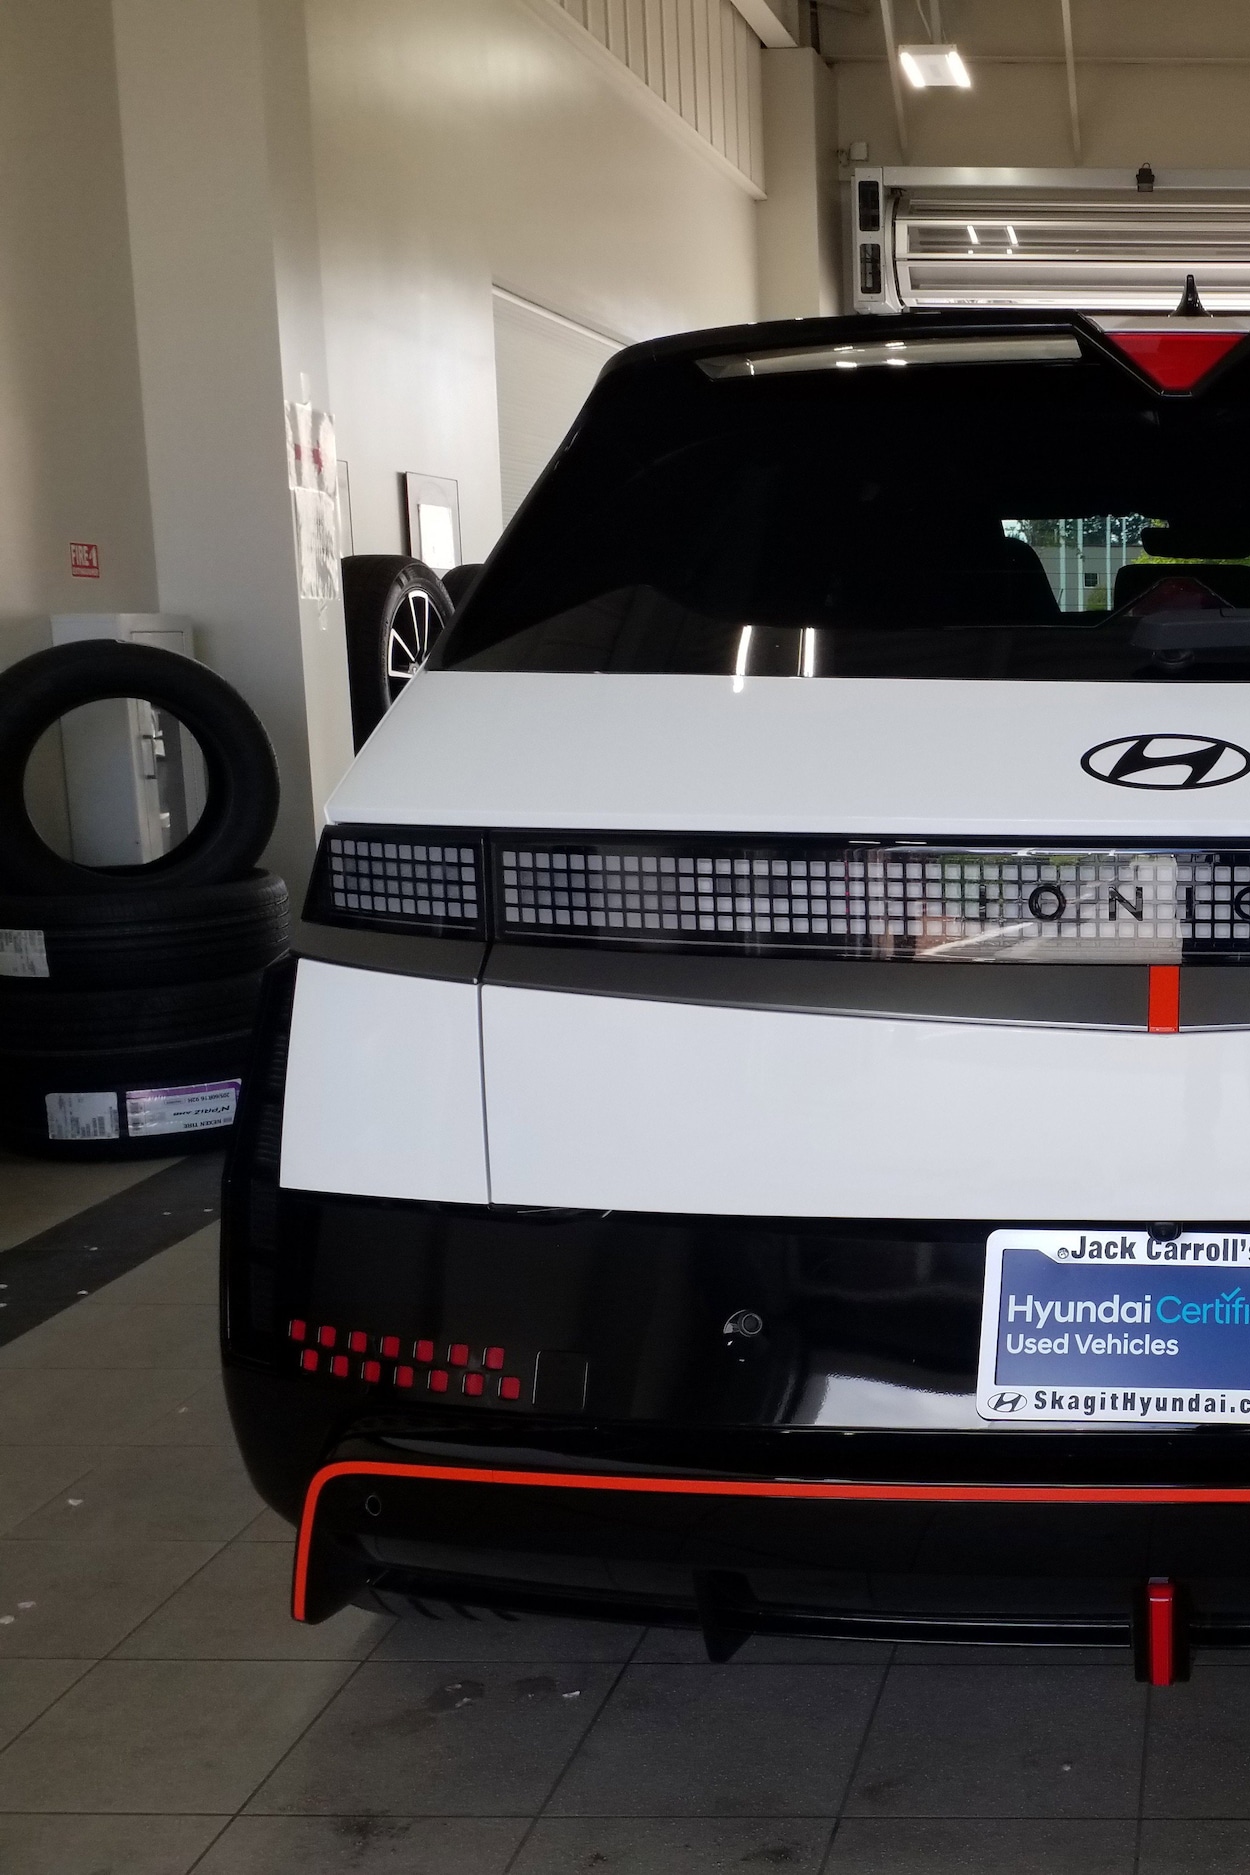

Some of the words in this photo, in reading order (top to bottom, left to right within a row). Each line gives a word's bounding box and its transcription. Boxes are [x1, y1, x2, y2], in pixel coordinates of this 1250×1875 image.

[1071, 1236, 1136, 1260] Jack
[1007, 1294, 1150, 1328] Hyundai
[1006, 1333, 1069, 1355] Used
[1074, 1333, 1179, 1356] Vehicles
